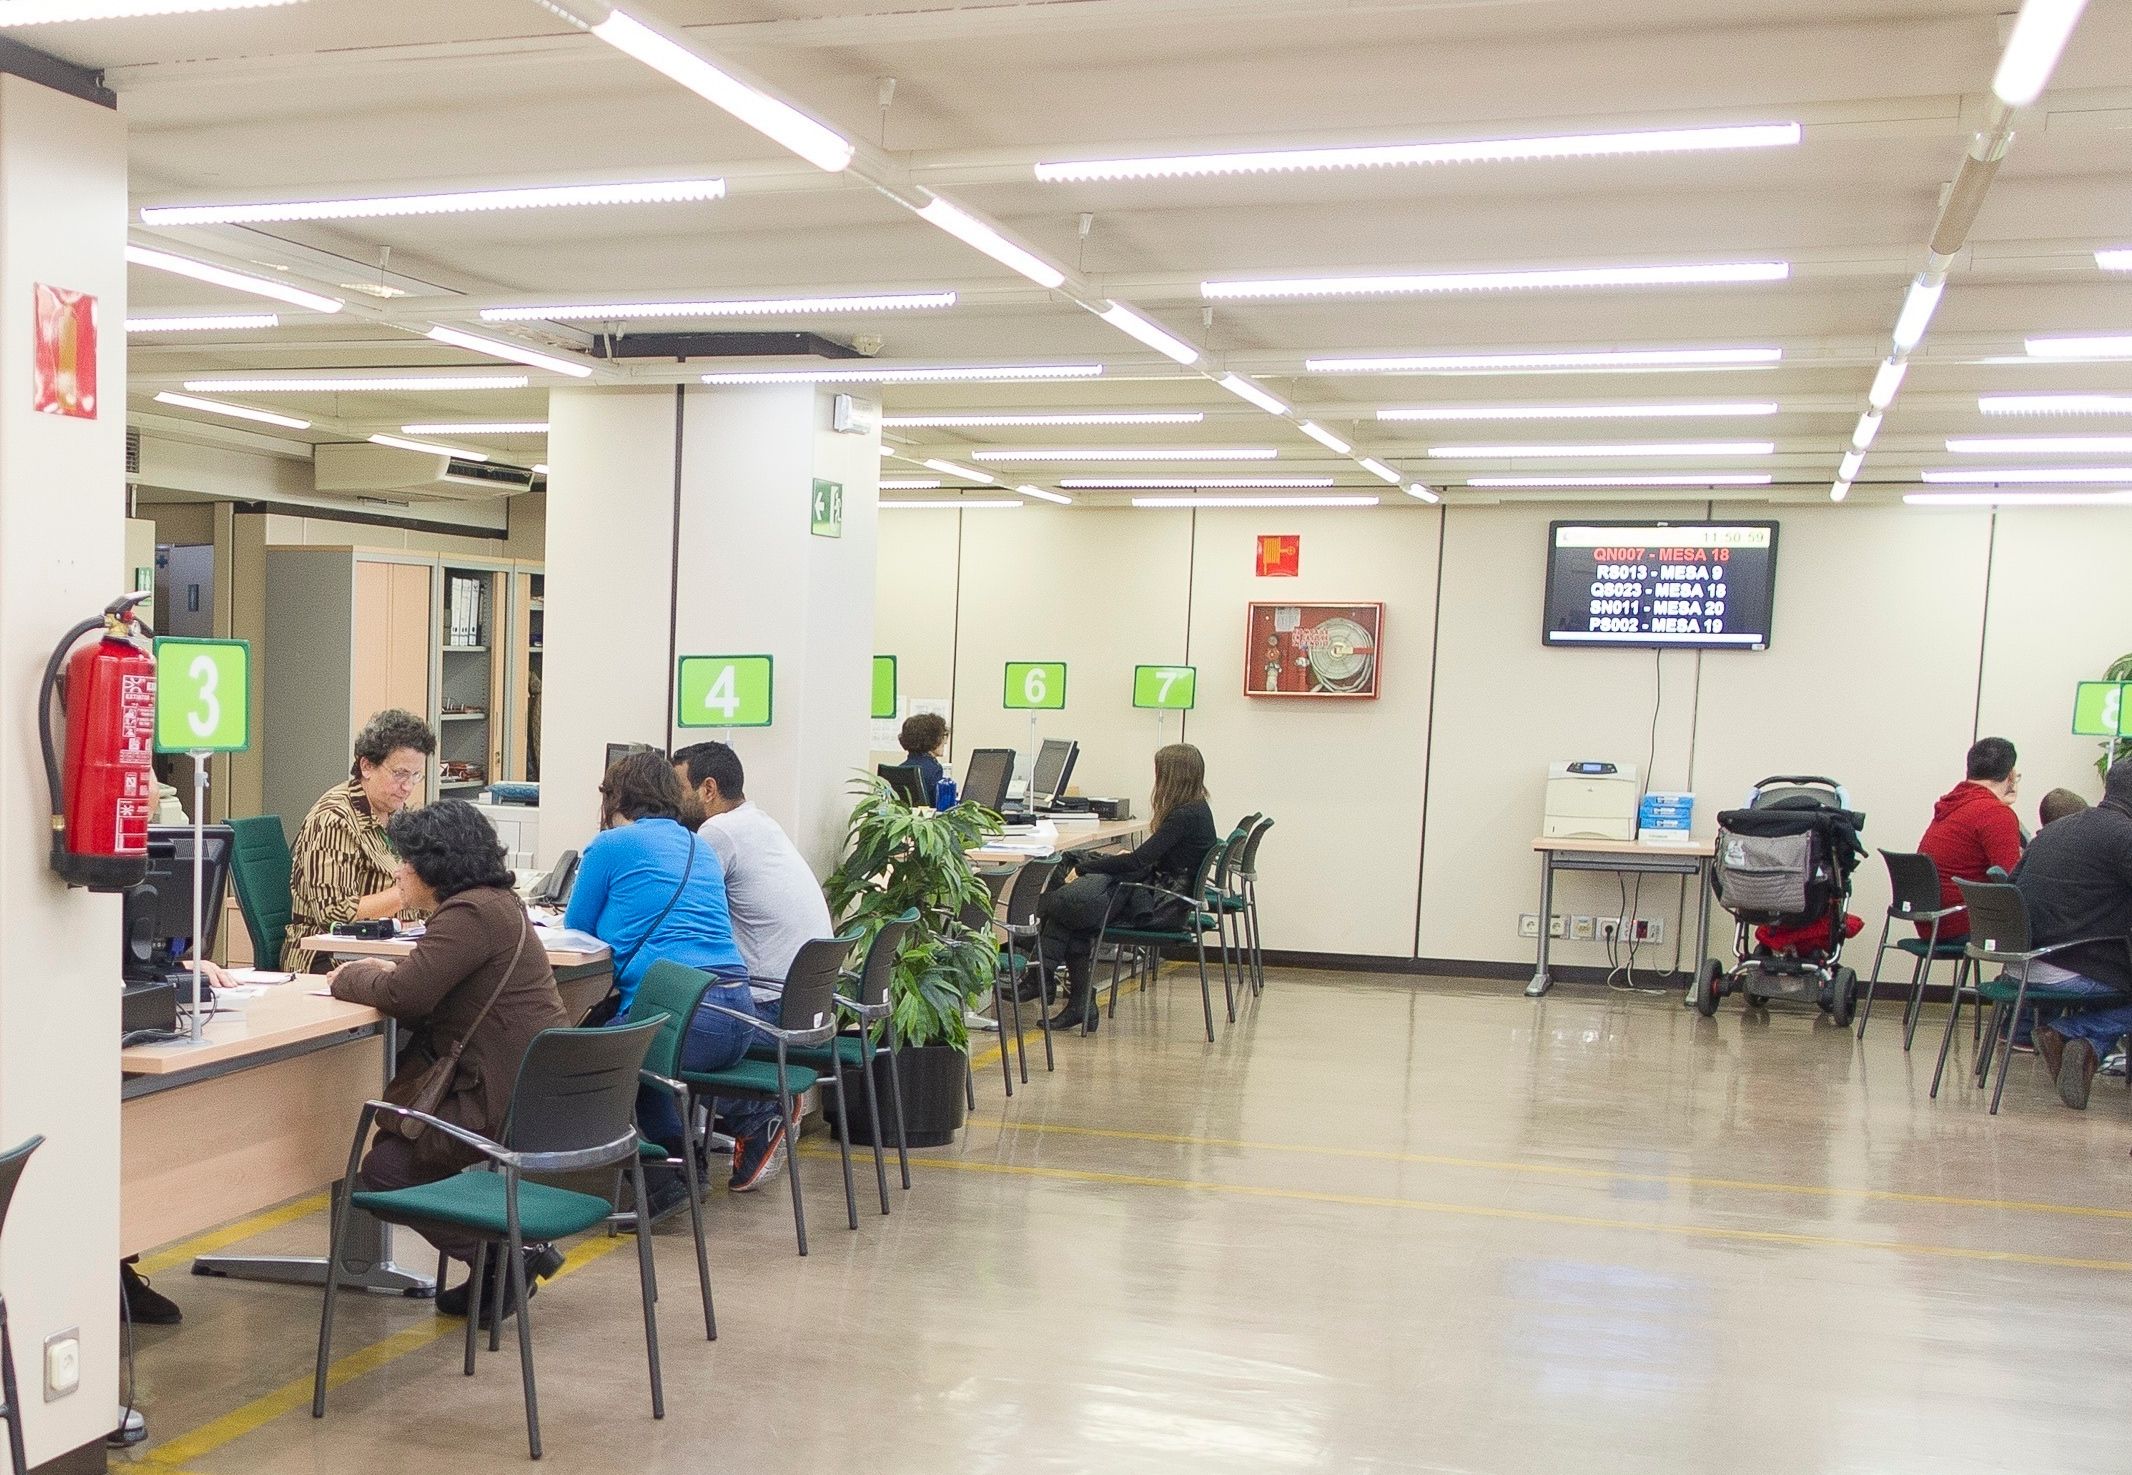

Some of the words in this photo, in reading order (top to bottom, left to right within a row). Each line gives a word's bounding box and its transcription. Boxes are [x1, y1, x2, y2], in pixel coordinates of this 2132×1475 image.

[1593, 547, 1646, 561] QN007
[1659, 548, 1707, 561] MESA
[1712, 548, 1730, 562] 18
[1596, 564, 1648, 580] RS013
[1660, 565, 1710, 580] MESA
[1711, 565, 1723, 580] 9
[1590, 582, 1643, 598] QS023
[1655, 582, 1704, 598] MESA
[1707, 583, 1727, 598] 18
[1589, 599, 1639, 615] SN011
[1653, 600, 1702, 616] MESA
[1704, 600, 1725, 616] 20
[1589, 617, 1639, 632] PS002
[1651, 617, 1701, 633] MESA
[1703, 618, 1723, 633] 19
[704, 664, 741, 719] 4
[1024, 667, 1047, 704] 6
[1155, 671, 1178, 704] 7
[187, 654, 220, 738] 3
